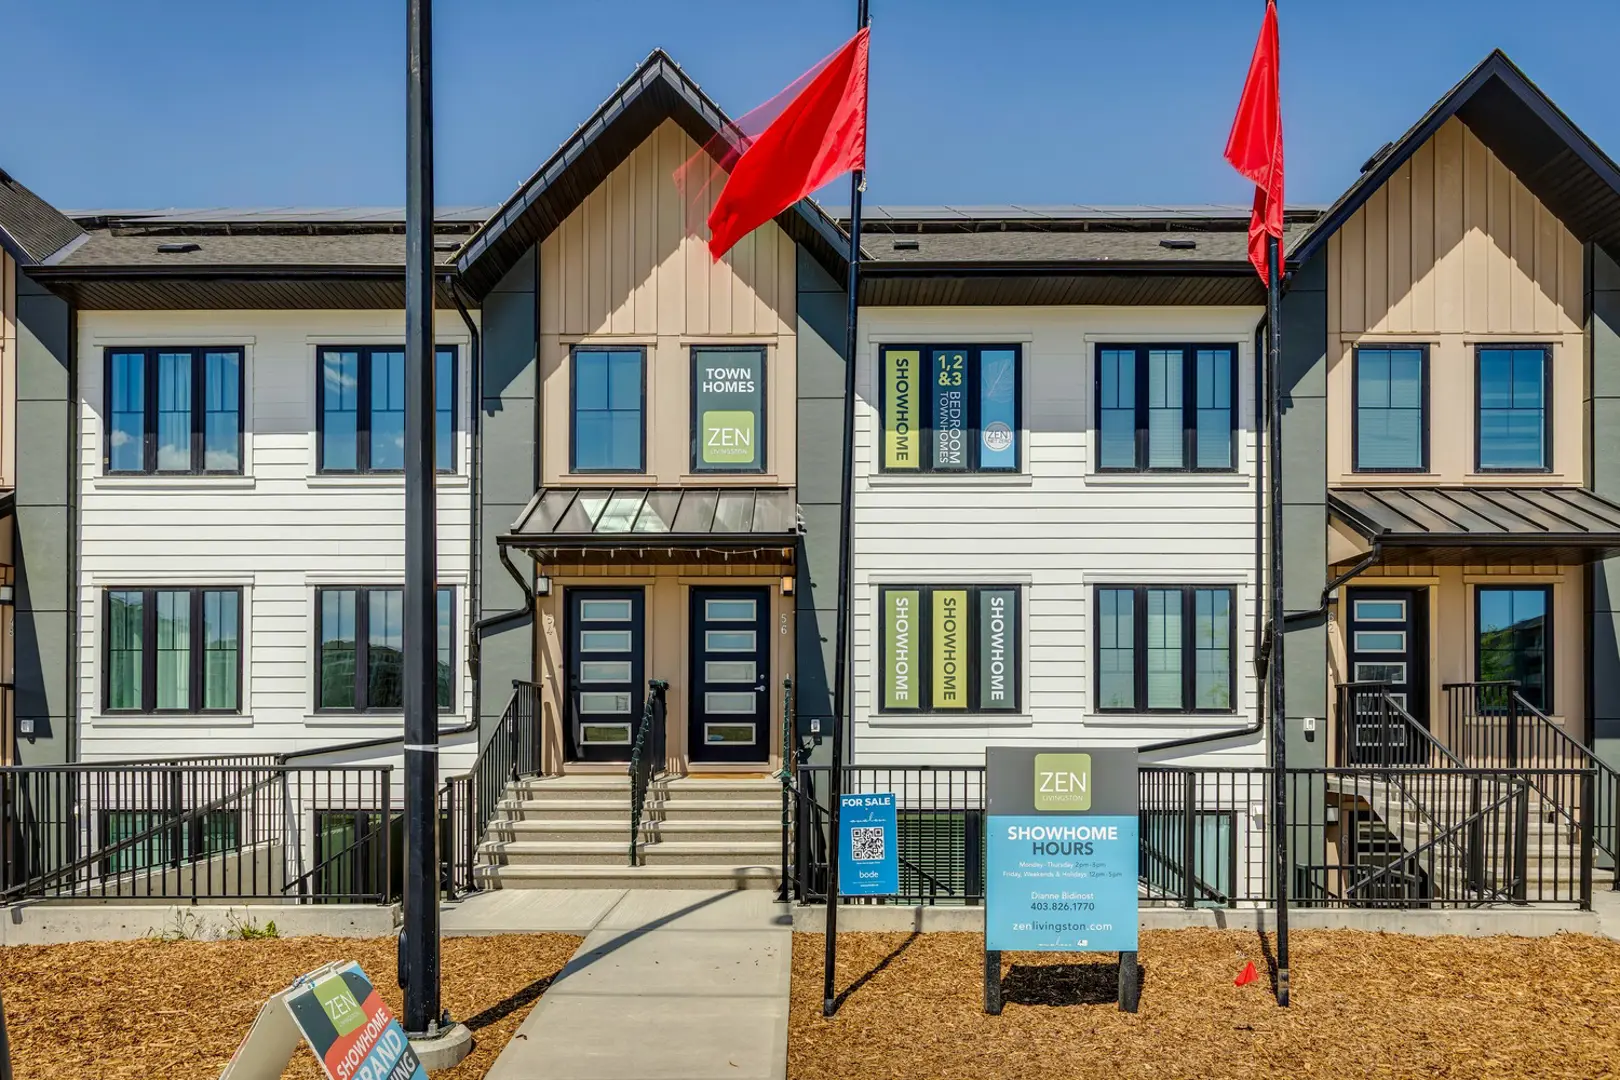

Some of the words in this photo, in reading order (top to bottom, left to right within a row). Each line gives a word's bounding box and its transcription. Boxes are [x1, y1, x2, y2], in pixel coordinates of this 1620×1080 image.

[705, 368, 751, 380] TOWN
[938, 371, 962, 386] &3
[702, 381, 755, 393] HOMES
[895, 358, 909, 461] SHOWHOME
[940, 391, 949, 464] TOWNHOMES
[949, 391, 961, 464] BEDROOM
[988, 430, 1008, 439] ZEN
[707, 428, 750, 446] ZEN
[895, 597, 909, 701] SHOWHOME
[943, 597, 957, 701] SHOWHOME
[990, 597, 1005, 701] SHOWHOME
[1039, 771, 1087, 793] ZEN
[842, 798, 863, 807] FOR
[864, 797, 891, 806] SALE
[1042, 794, 1084, 802] LIVINGSTON
[1007, 826, 1118, 841] SHOWHOME
[1032, 841, 1094, 856] HOURS
[1019, 862, 1043, 870] Monday
[1047, 861, 1074, 870] Thursday
[859, 869, 879, 879] bode
[1023, 870, 1054, 878] Weekends
[1031, 892, 1059, 900] Dianne
[1030, 902, 1095, 911] 403.826.1770
[1012, 920, 1113, 933] zenlivingston.com
[324, 990, 358, 1020] ZEN
[337, 1007, 389, 1080] SHOWHOME
